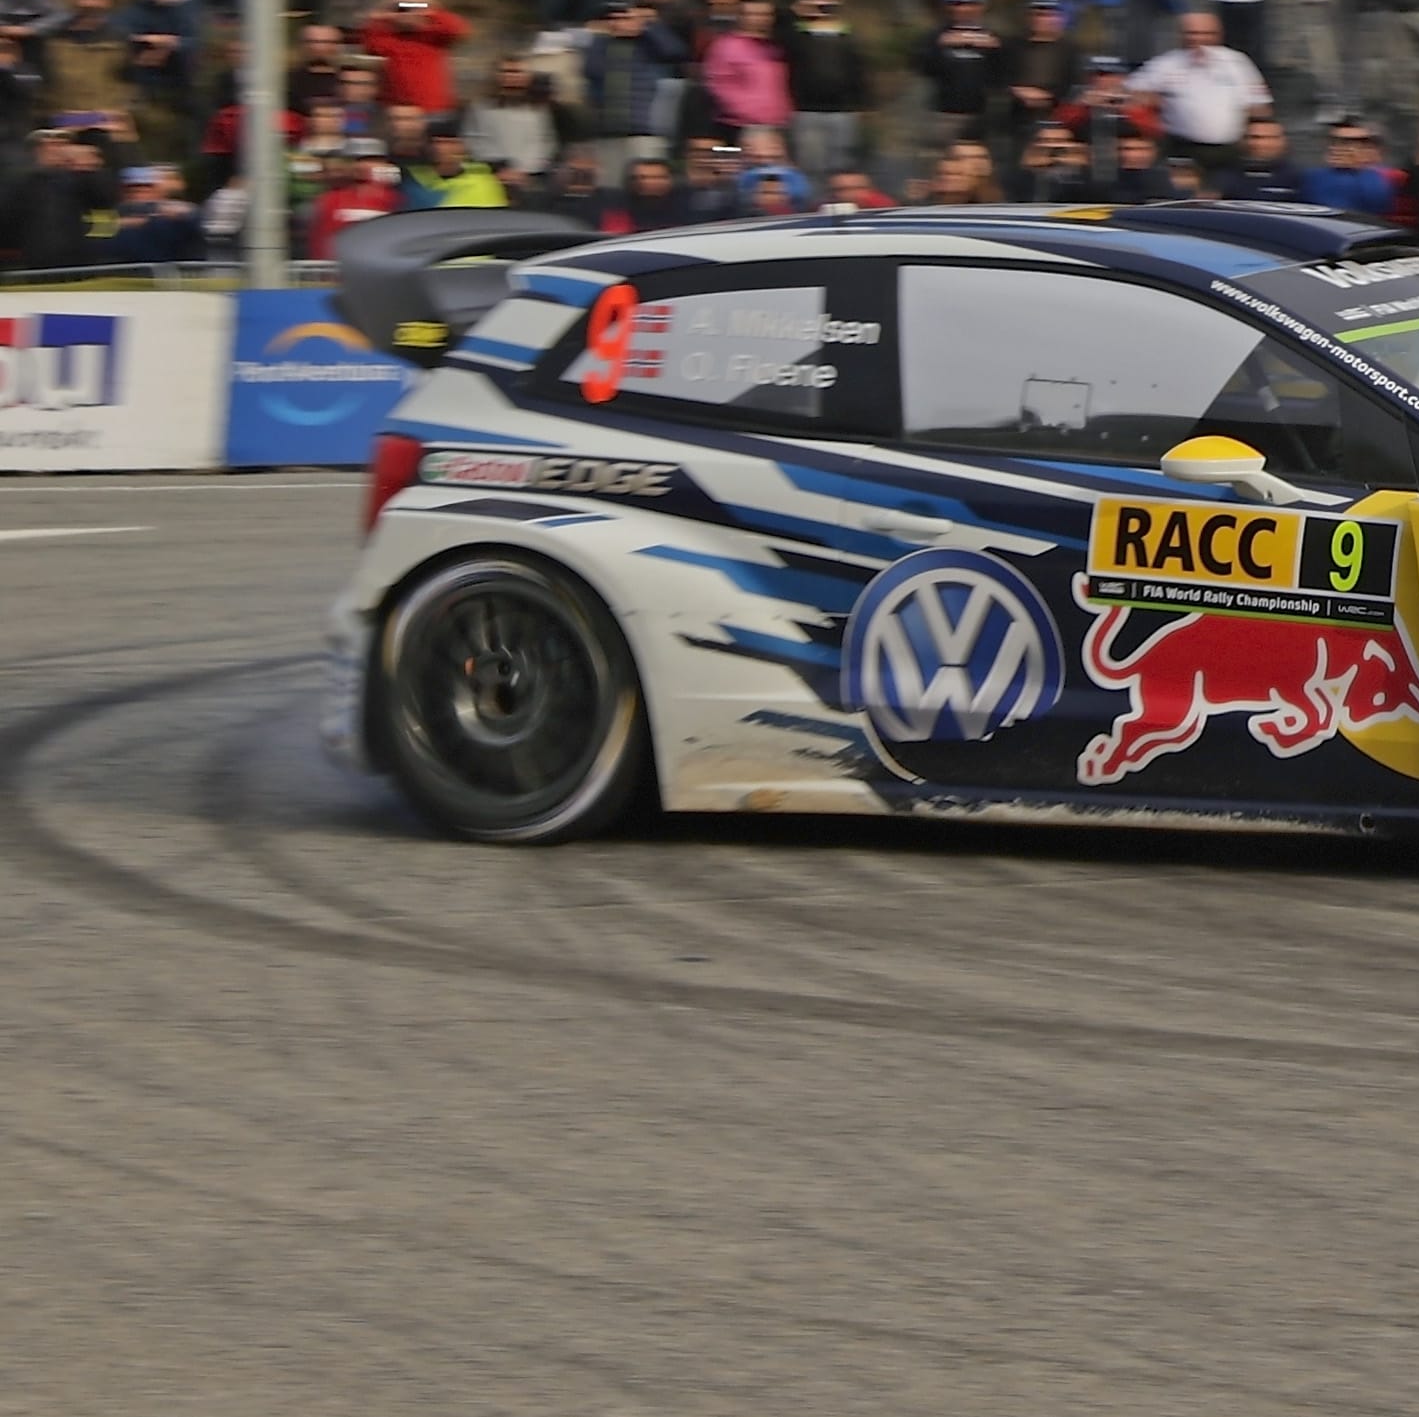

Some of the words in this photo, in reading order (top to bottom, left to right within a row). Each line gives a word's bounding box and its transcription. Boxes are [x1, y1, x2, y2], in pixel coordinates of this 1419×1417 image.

[581, 283, 639, 404] 9
[530, 456, 682, 497] EDGE
[1114, 506, 1277, 579] RACC
[1329, 520, 1364, 592] 9
[1143, 585, 1163, 599] FIA
[1164, 587, 1201, 602] World
[1203, 590, 1234, 607] Rally
[1236, 593, 1320, 614] Championship
